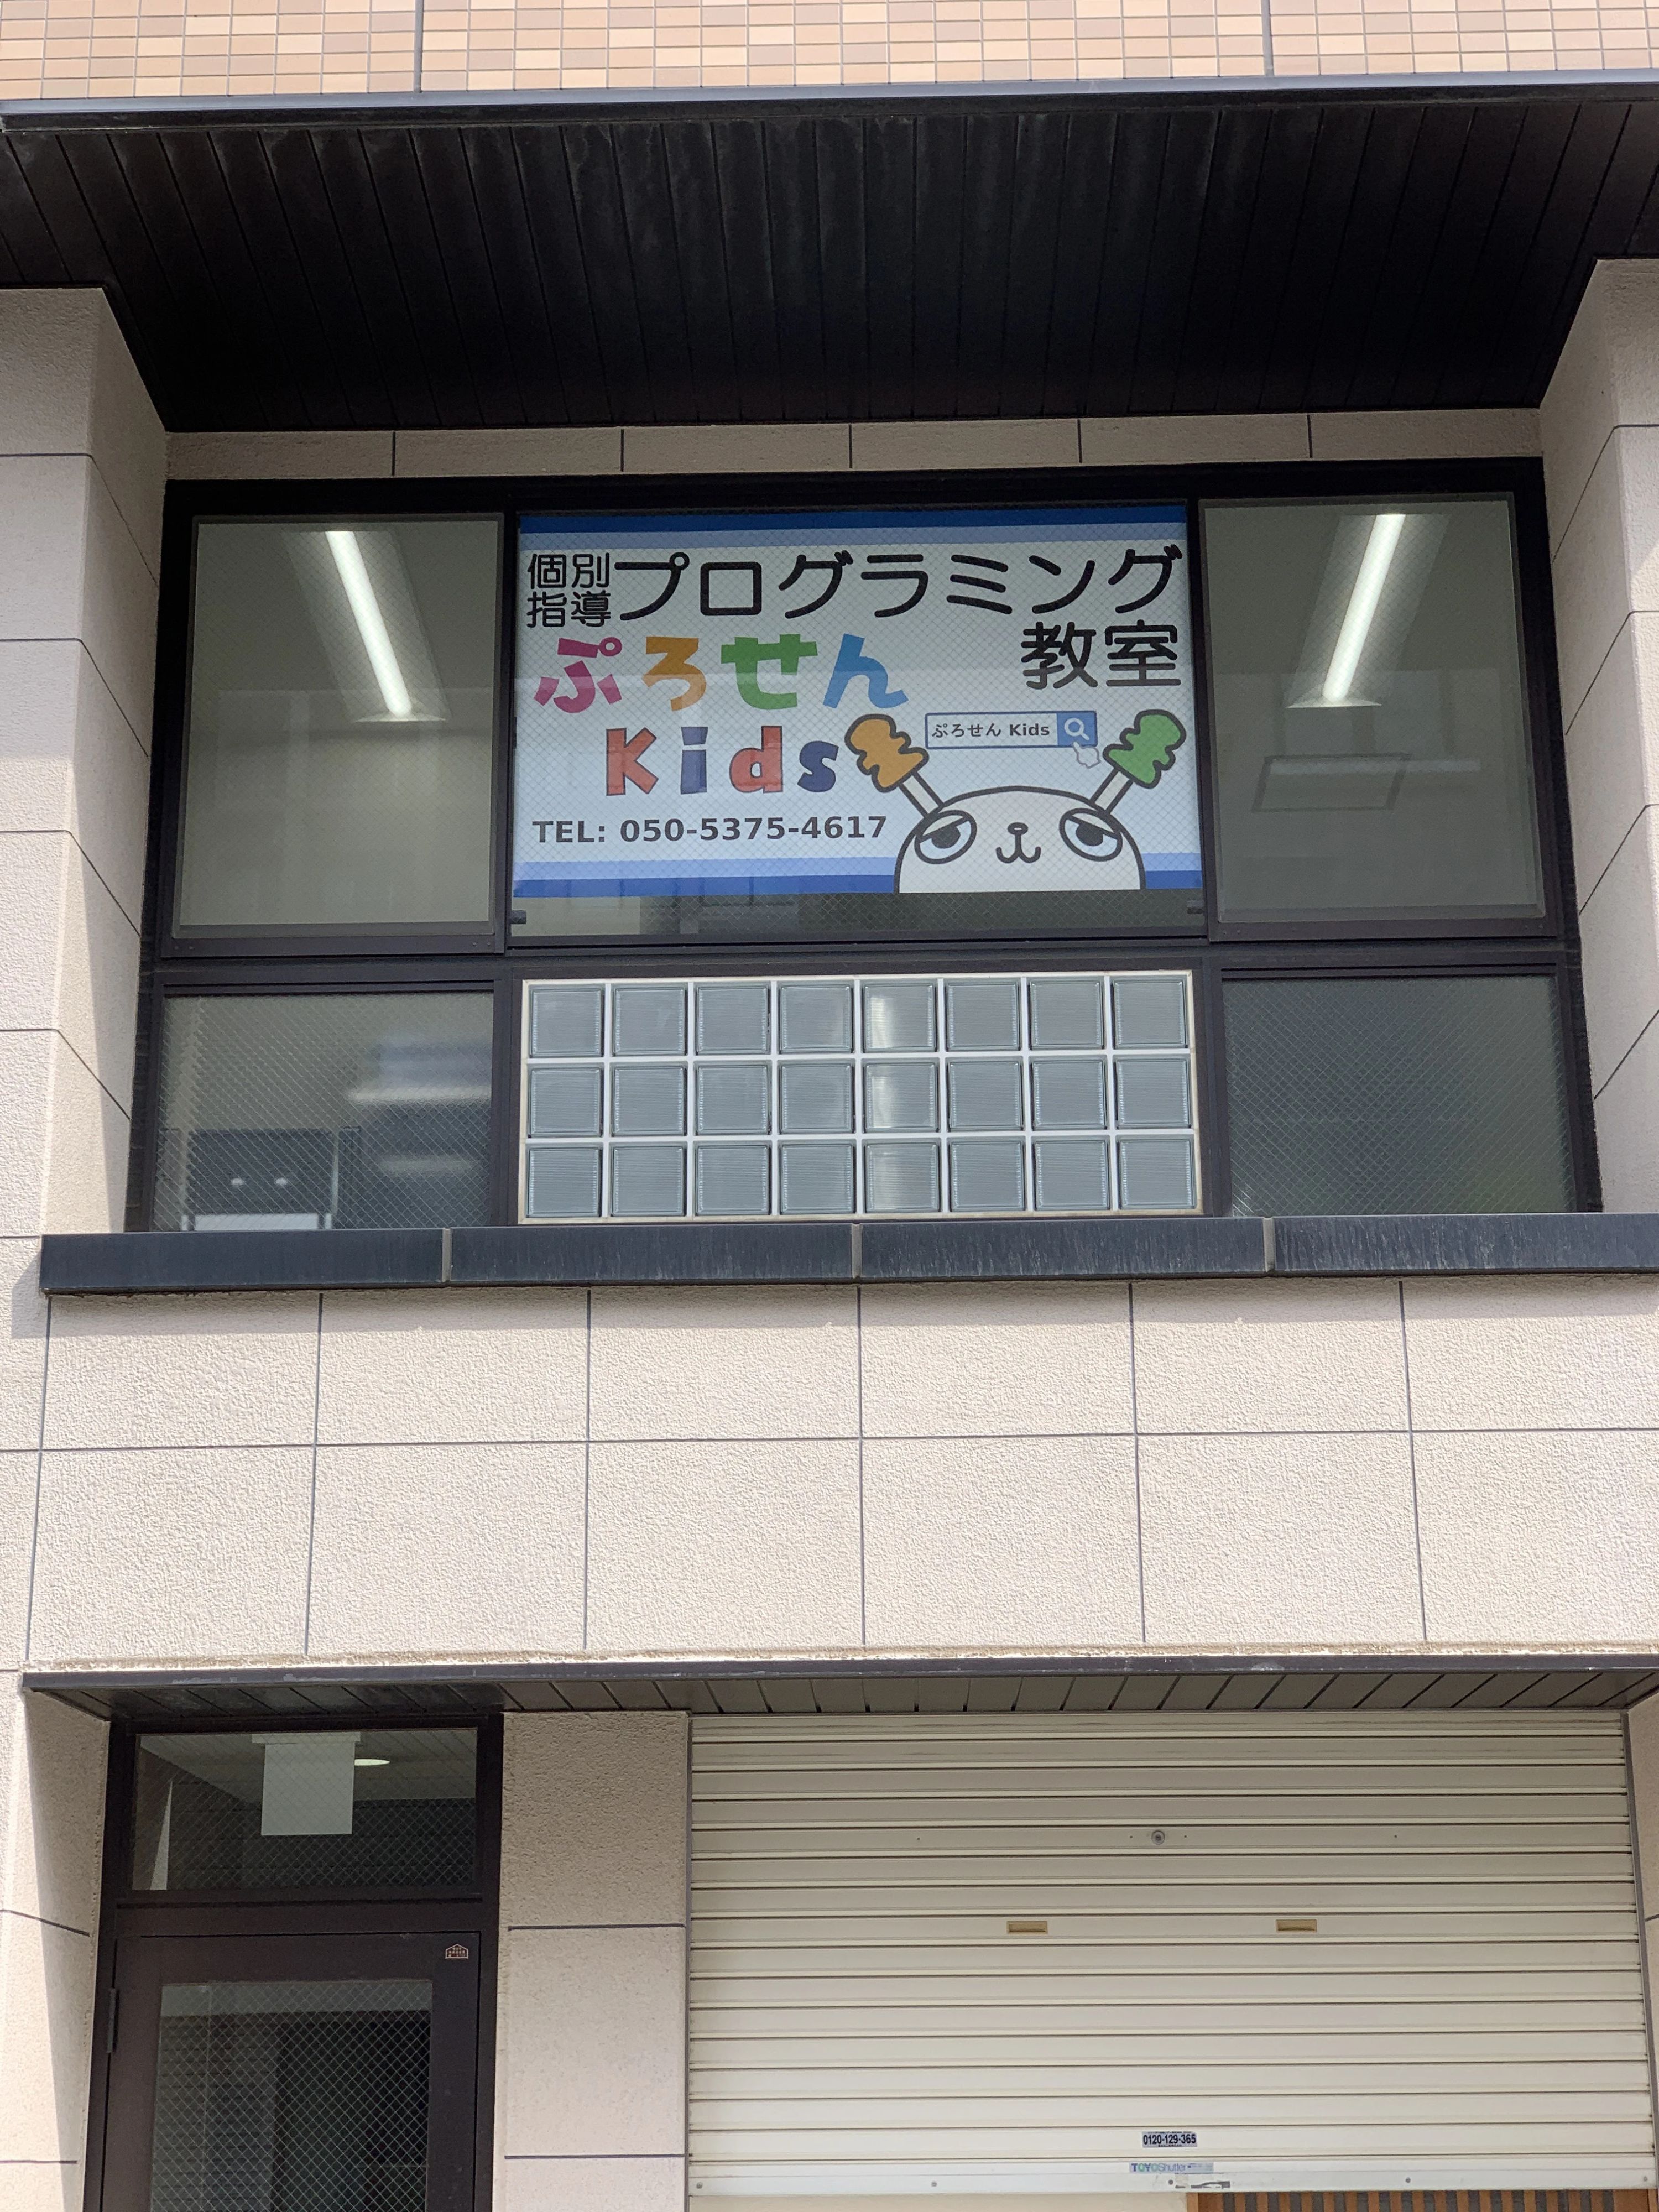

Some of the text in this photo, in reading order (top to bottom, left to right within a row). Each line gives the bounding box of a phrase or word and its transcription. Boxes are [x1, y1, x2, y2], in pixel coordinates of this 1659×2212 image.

[527, 552, 610, 589] 個別
[614, 544, 1183, 620] プログラミング
[526, 590, 611, 628] 指導
[534, 633, 909, 713] ぷろせん
[1021, 619, 1181, 690] 教室
[931, 723, 1050, 738] ぷろせん Kids
[606, 725, 839, 796] Kids
[532, 816, 886, 843] TEL: 050-5375-4617
[1143, 2134, 1196, 2145] 0120-129-365
